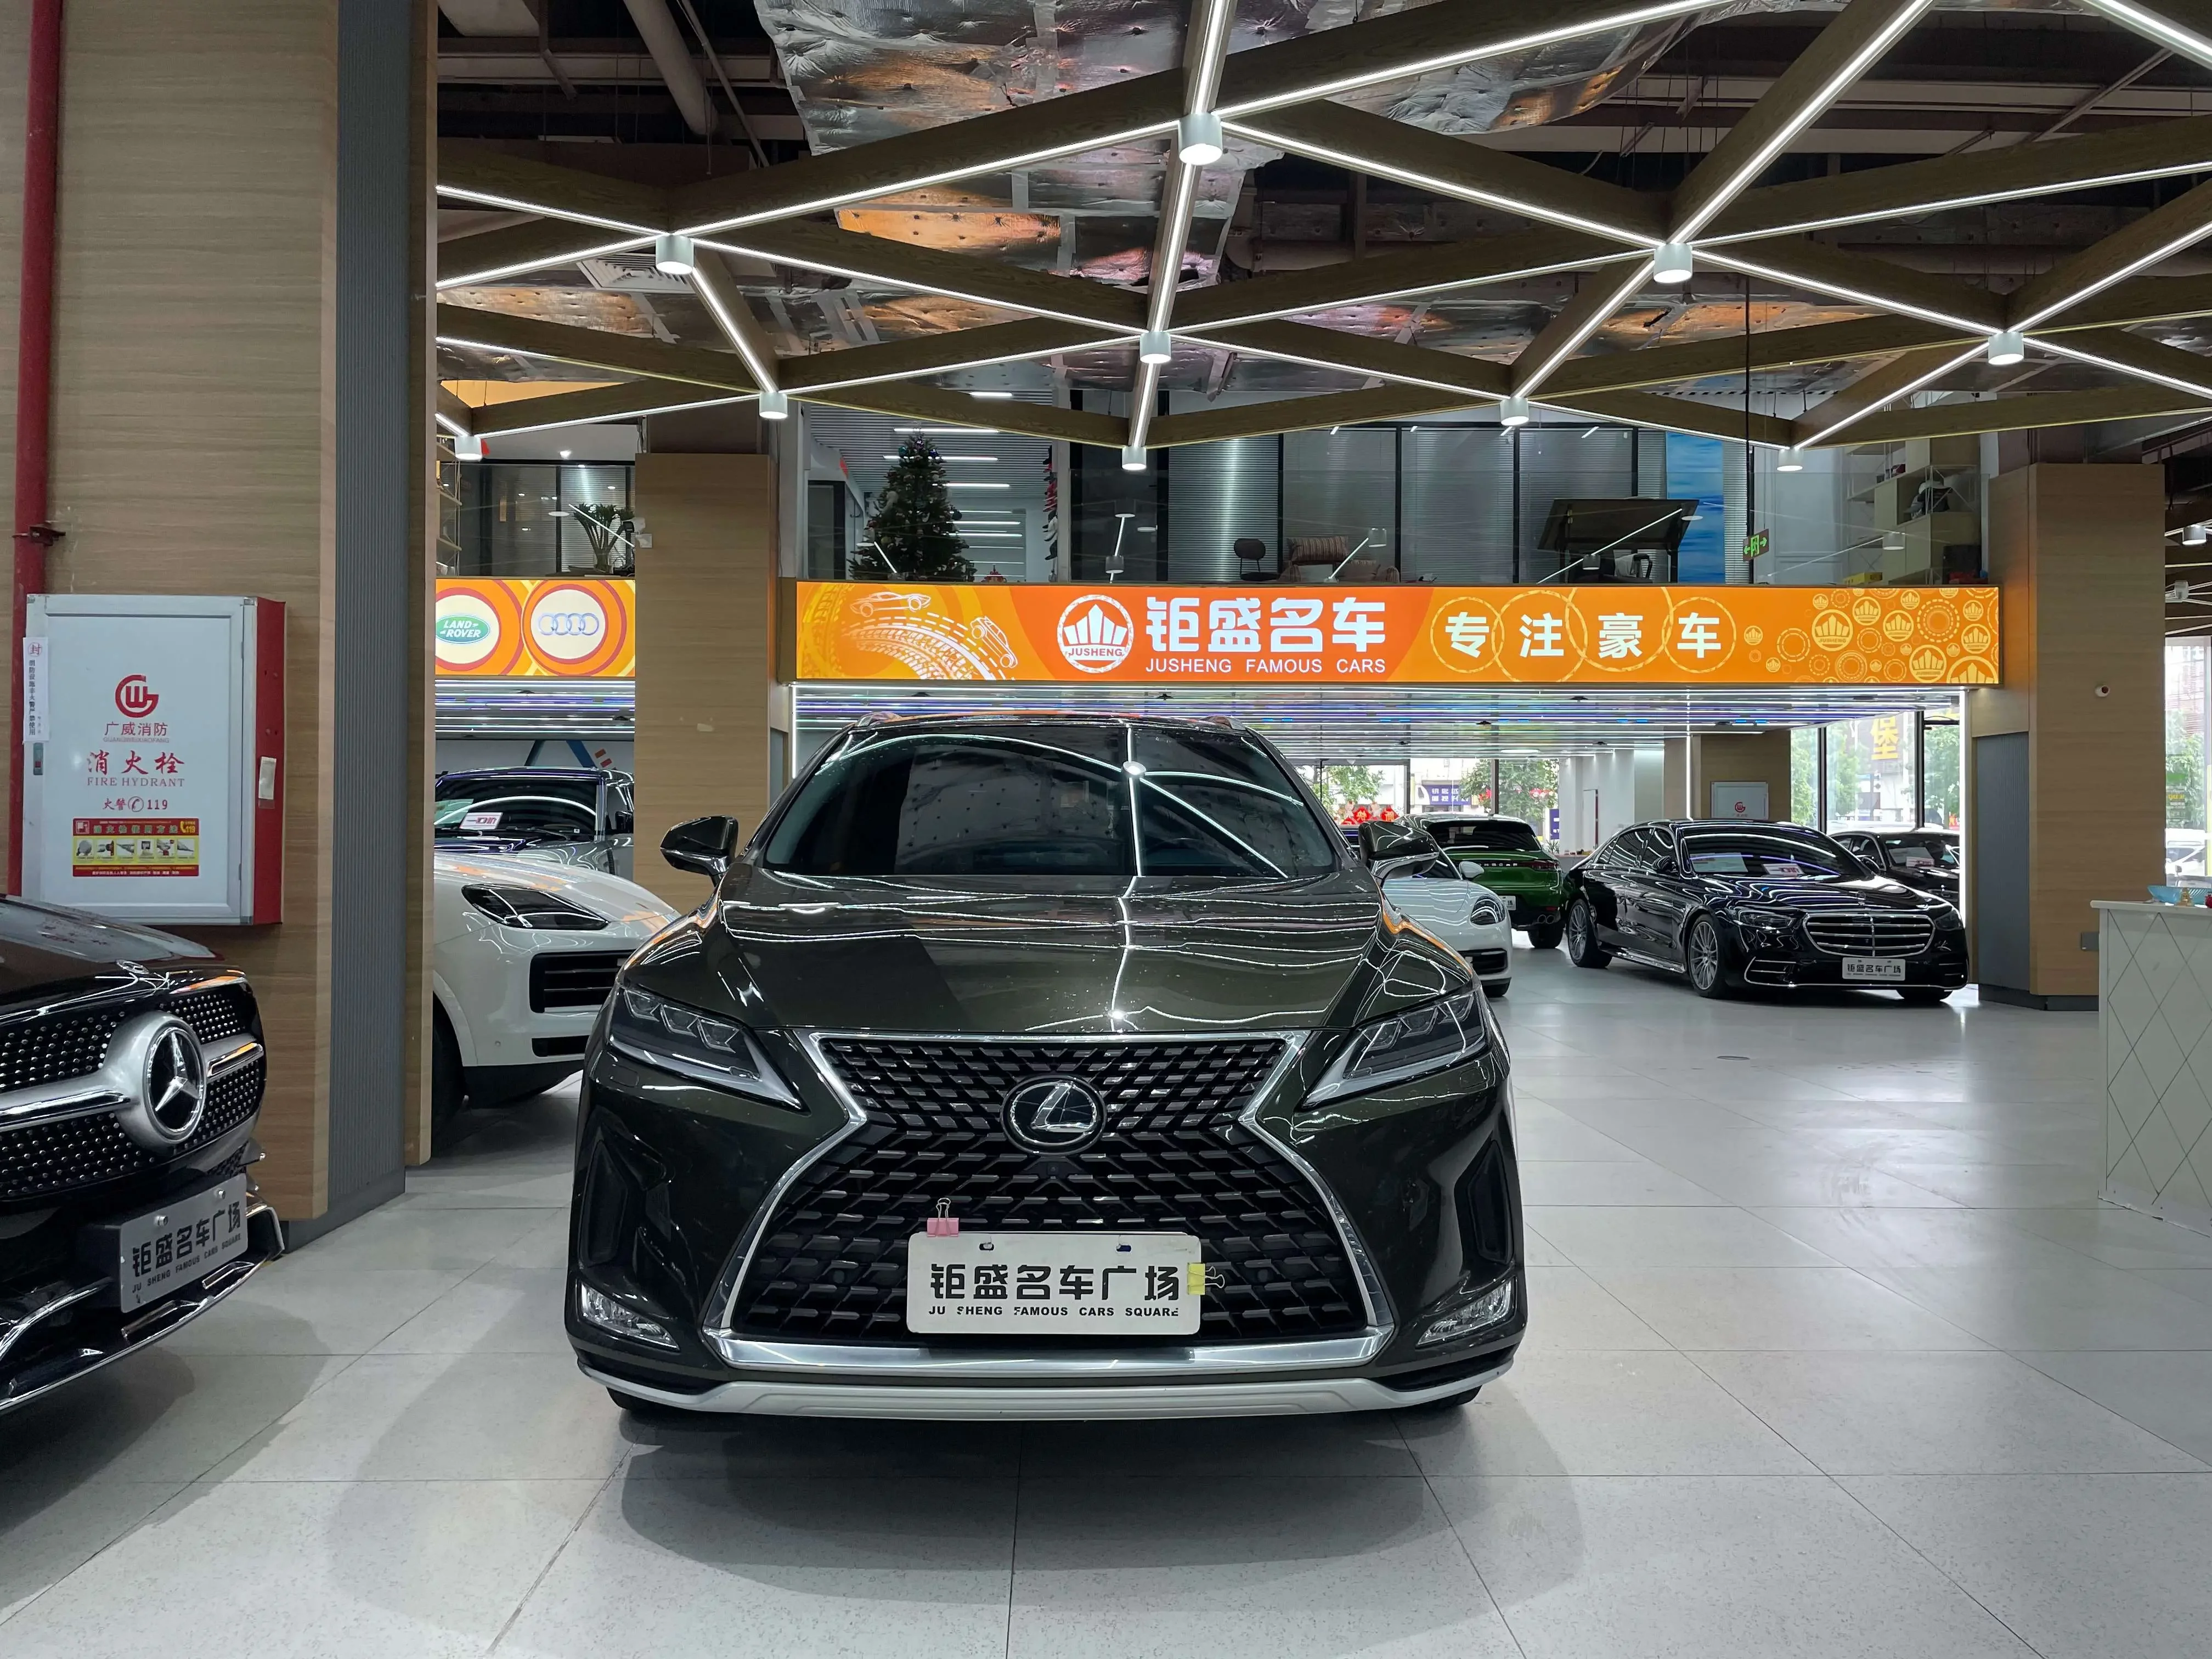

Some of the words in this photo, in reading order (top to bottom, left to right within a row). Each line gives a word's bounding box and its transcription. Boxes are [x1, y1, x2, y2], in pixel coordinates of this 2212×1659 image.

[443, 619, 472, 628] LAND
[1146, 597, 1385, 652] 钜盛名车
[446, 628, 481, 637] ROVER
[1445, 612, 1722, 658] 专注豪车
[1069, 648, 1122, 656] JUSHENG
[1146, 659, 1231, 673] JUSHENG
[1246, 659, 1322, 673] FAMOUS
[1336, 659, 1385, 673] CARS
[104, 721, 168, 736] 广威消防
[1870, 715, 1899, 760] 堡
[87, 749, 184, 775] 消火栓
[87, 777, 117, 786] FIRE
[122, 777, 185, 787] HYDRANT
[103, 798, 126, 810] 火警
[147, 799, 168, 810] 119
[132, 1201, 241, 1277] 钜盛名车广场
[930, 1263, 1179, 1300] 钜盛名车广场
[929, 1306, 946, 1315] JU
[957, 1306, 1002, 1315] SHENG
[1014, 1306, 1068, 1316] FAMOUS
[1079, 1307, 1114, 1316] CARS
[1125, 1307, 1179, 1317] SQUARE
